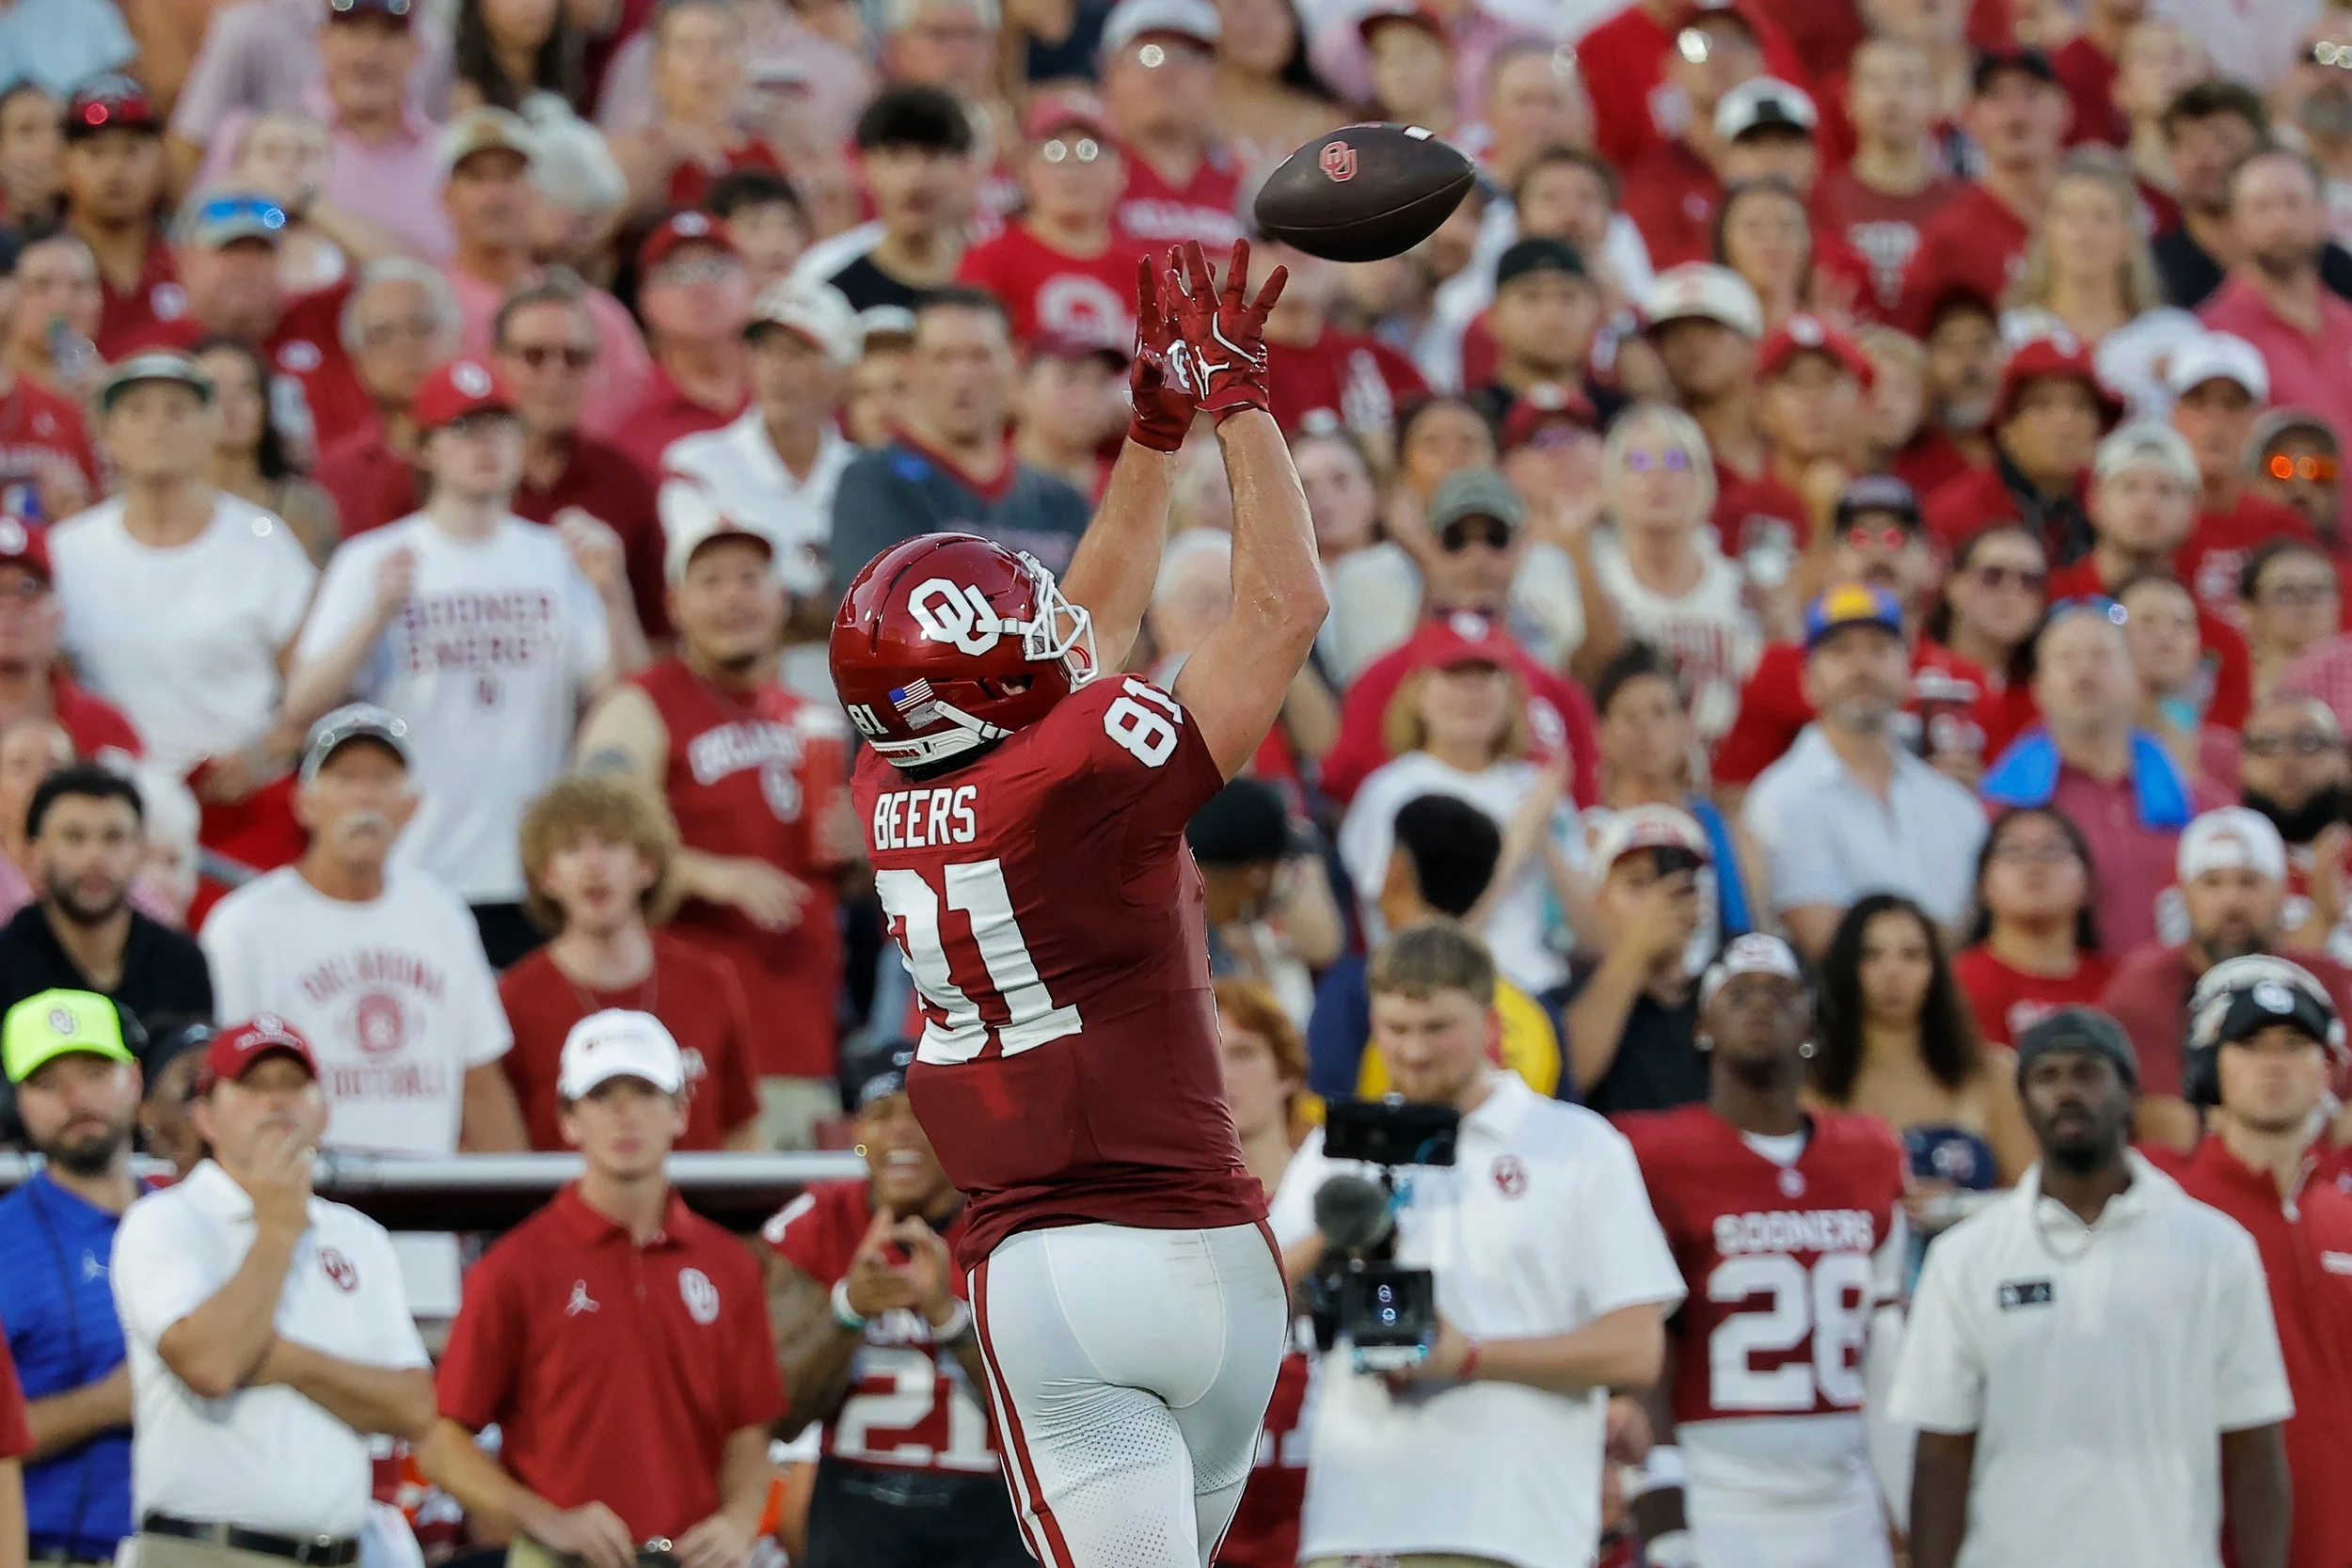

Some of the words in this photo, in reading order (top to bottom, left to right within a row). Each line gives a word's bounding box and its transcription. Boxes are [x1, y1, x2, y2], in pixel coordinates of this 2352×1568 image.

[1319, 140, 1358, 182] OU
[908, 578, 1000, 657] OU
[848, 704, 889, 735] 81
[1103, 676, 1184, 768] 81
[873, 784, 977, 850] BEERS
[1712, 1210, 1874, 1257] SOONERS
[1707, 1253, 1872, 1411] 28
